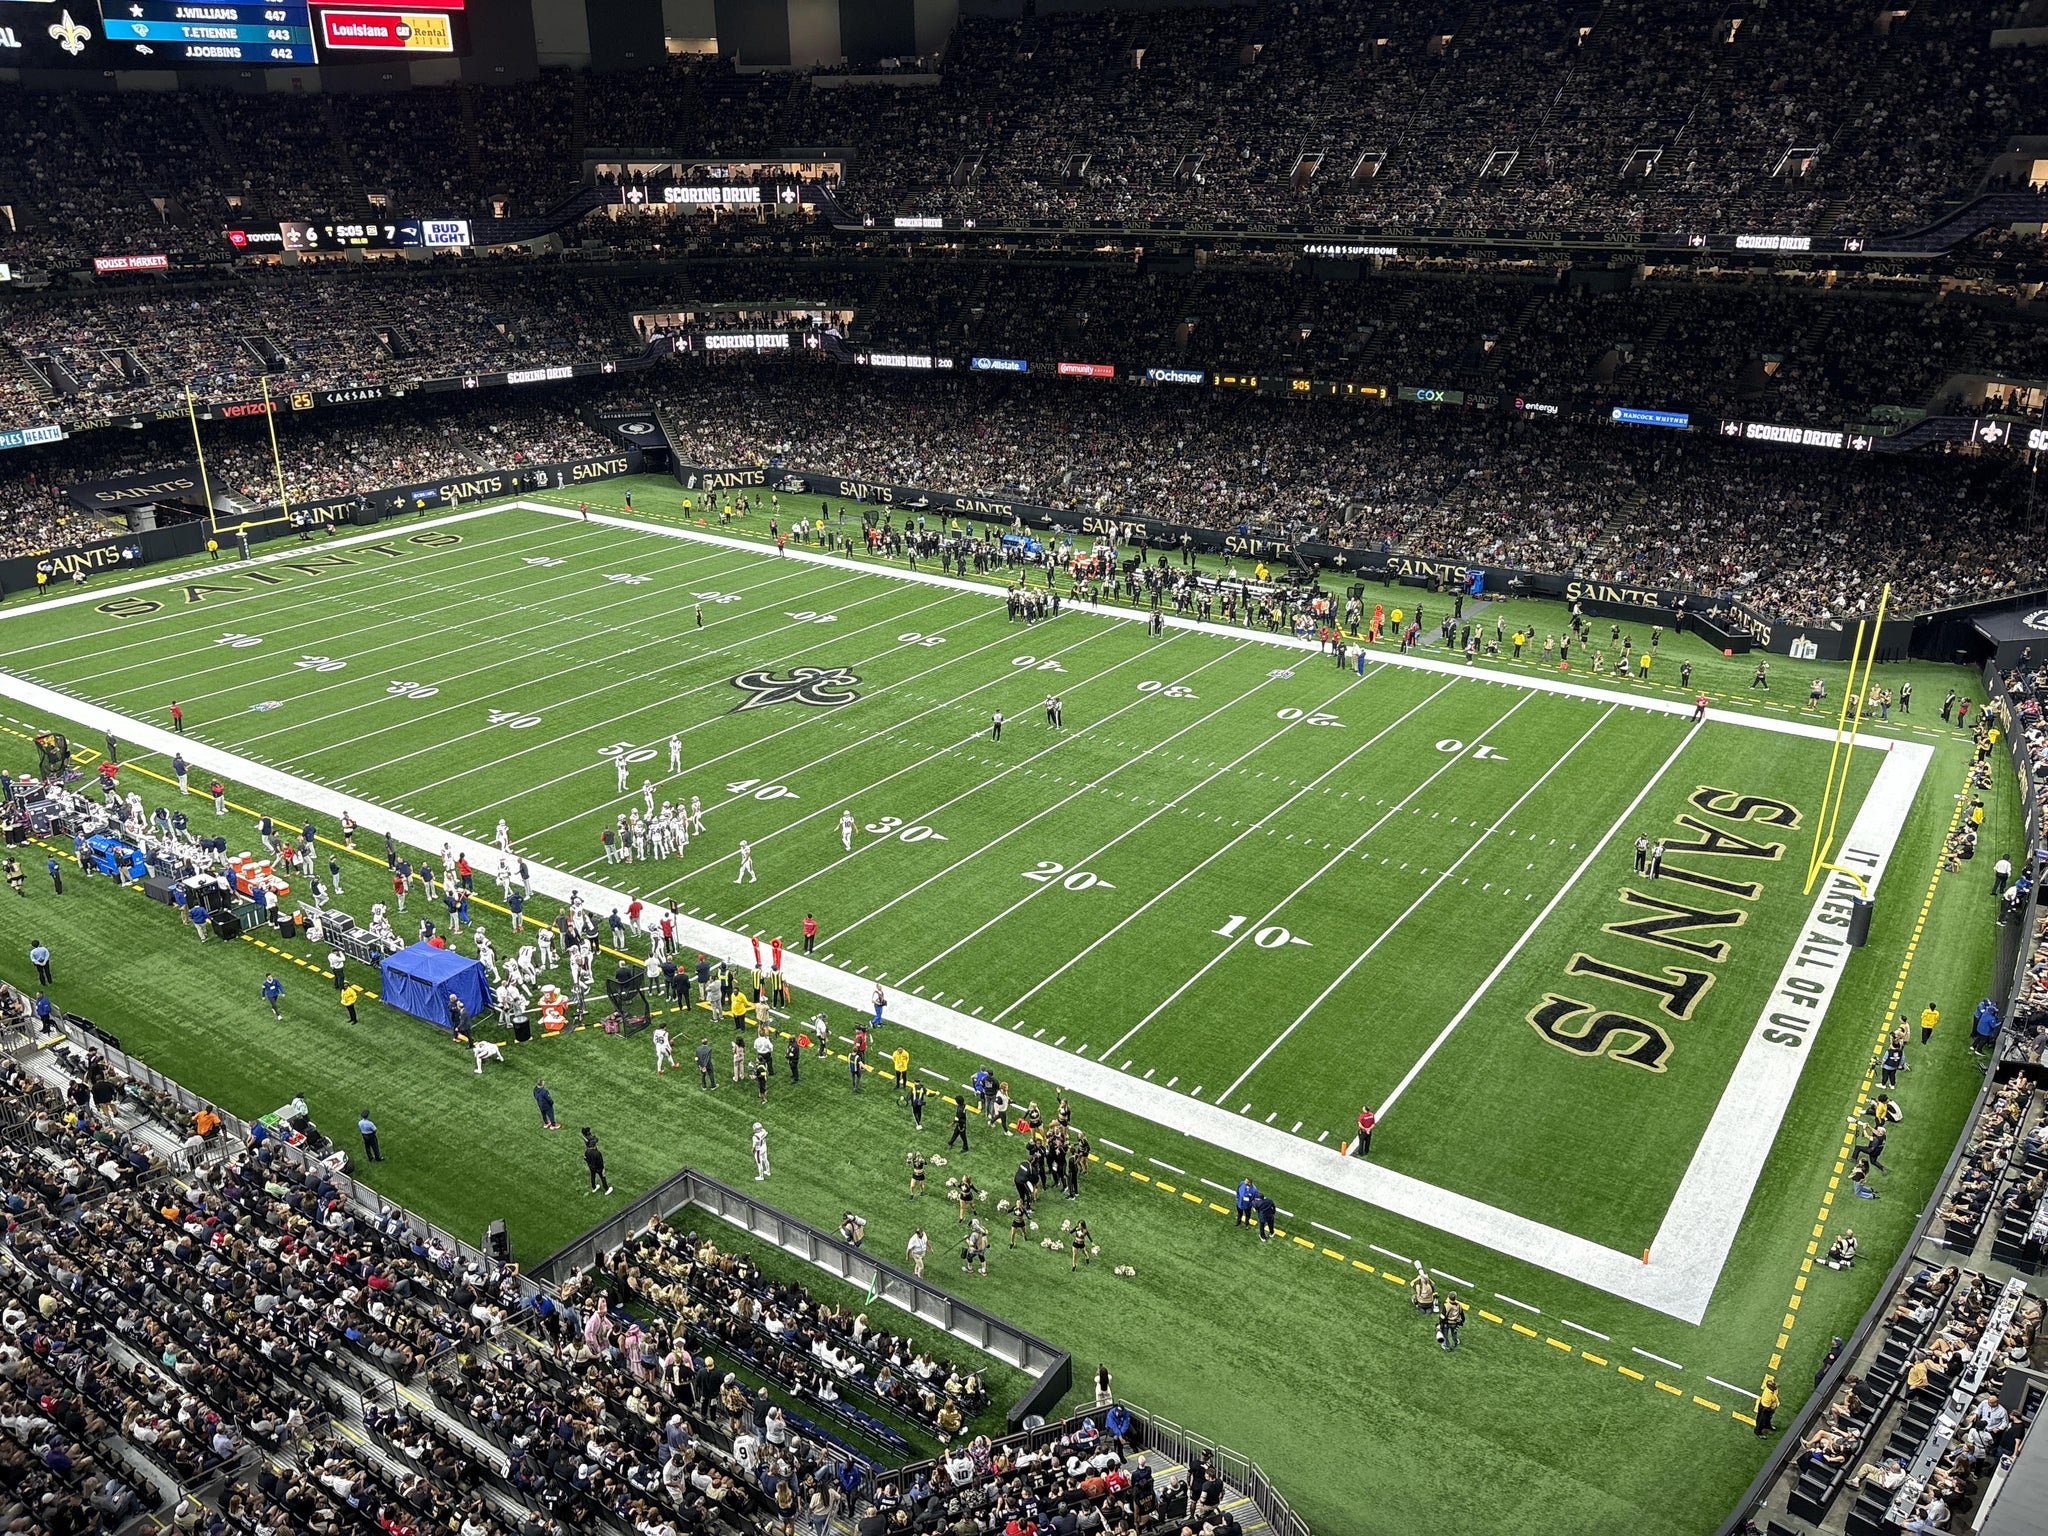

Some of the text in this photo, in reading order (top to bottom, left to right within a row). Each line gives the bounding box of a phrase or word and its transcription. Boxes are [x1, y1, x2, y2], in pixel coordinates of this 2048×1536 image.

[176, 8, 286, 22] J.WILLIAMS 447
[182, 26, 290, 41] T.ETIENNE 443
[332, 22, 388, 38] Louisiana
[414, 28, 446, 37] Rental
[186, 46, 293, 60] J.DOBBINS 442
[664, 186, 760, 203] SCORING DRIVE
[432, 224, 459, 234] BUD
[1003, 220, 1030, 228] SAINTS
[1122, 221, 1150, 229] SAINTS
[1184, 223, 1214, 231] SAINTS
[1248, 224, 1278, 232] SAINTS
[1314, 226, 1344, 234] SAINTS
[1381, 227, 1414, 236] SAINTS
[247, 233, 282, 242] TOYOTA
[306, 228, 318, 241] 6
[337, 226, 364, 236] 5:05
[384, 226, 395, 239] 7
[428, 234, 464, 244] LIGHT
[1453, 229, 1487, 238] SAINTS
[1526, 231, 1561, 240] SAINTS
[1604, 233, 1640, 242] SAINTS
[1304, 245, 1398, 256] CAESARS SUPERDOME
[1736, 236, 1811, 250] SCORING DRIVE
[96, 256, 167, 269] ROUSES MARKETS
[705, 334, 790, 348] SCORING DRIVE
[871, 354, 932, 368] SCORING DRIVE
[938, 360, 952, 368] 2:00
[507, 366, 573, 384] SCORING DRIVE
[1060, 364, 1094, 376] Community
[1156, 370, 1202, 384] Ochsner
[389, 381, 419, 392] SAINTS
[293, 394, 310, 408] 25
[326, 389, 382, 404] CAESARS
[222, 402, 277, 418] verizon
[1526, 401, 1558, 414] entergy
[74, 418, 112, 430] SAINTS
[1624, 412, 1688, 424] HANCOCK WHITNEY
[25, 427, 60, 442] HEALTH
[1746, 423, 1843, 448] SCORING DRIVE
[573, 458, 628, 480] SAINTS
[702, 470, 764, 488] SAINTS
[96, 478, 194, 501] SAINTS
[440, 476, 502, 502] SAINTS
[955, 499, 1012, 516] SAINTS
[530, 556, 568, 568] 10
[95, 531, 463, 619] SAINTS
[1387, 558, 1467, 583] SAINTS
[608, 573, 653, 584] 20
[698, 591, 742, 604] 30
[1566, 581, 1658, 607] SAINTS
[791, 611, 838, 624] 40
[214, 633, 262, 648] 10
[898, 632, 946, 648] 50
[295, 656, 347, 672] 20
[1011, 655, 1062, 672] 40
[386, 680, 439, 699] 30
[1136, 680, 1192, 698] 30
[487, 709, 542, 729] 40
[1276, 707, 1337, 727] 20
[597, 742, 658, 762] 50
[1435, 738, 1498, 759] 10
[726, 778, 788, 800] 40
[865, 816, 934, 842] 30
[1844, 848, 1880, 868] IT
[1021, 860, 1098, 890] 20
[1212, 914, 1293, 948] 10
[1525, 785, 1804, 1073] SAINTS
[1795, 930, 1845, 968] ALL
[1780, 977, 1826, 1009] OF
[1762, 1012, 1810, 1048] US
[740, 1447, 748, 1460] 9
[958, 1470, 969, 1480] 10
